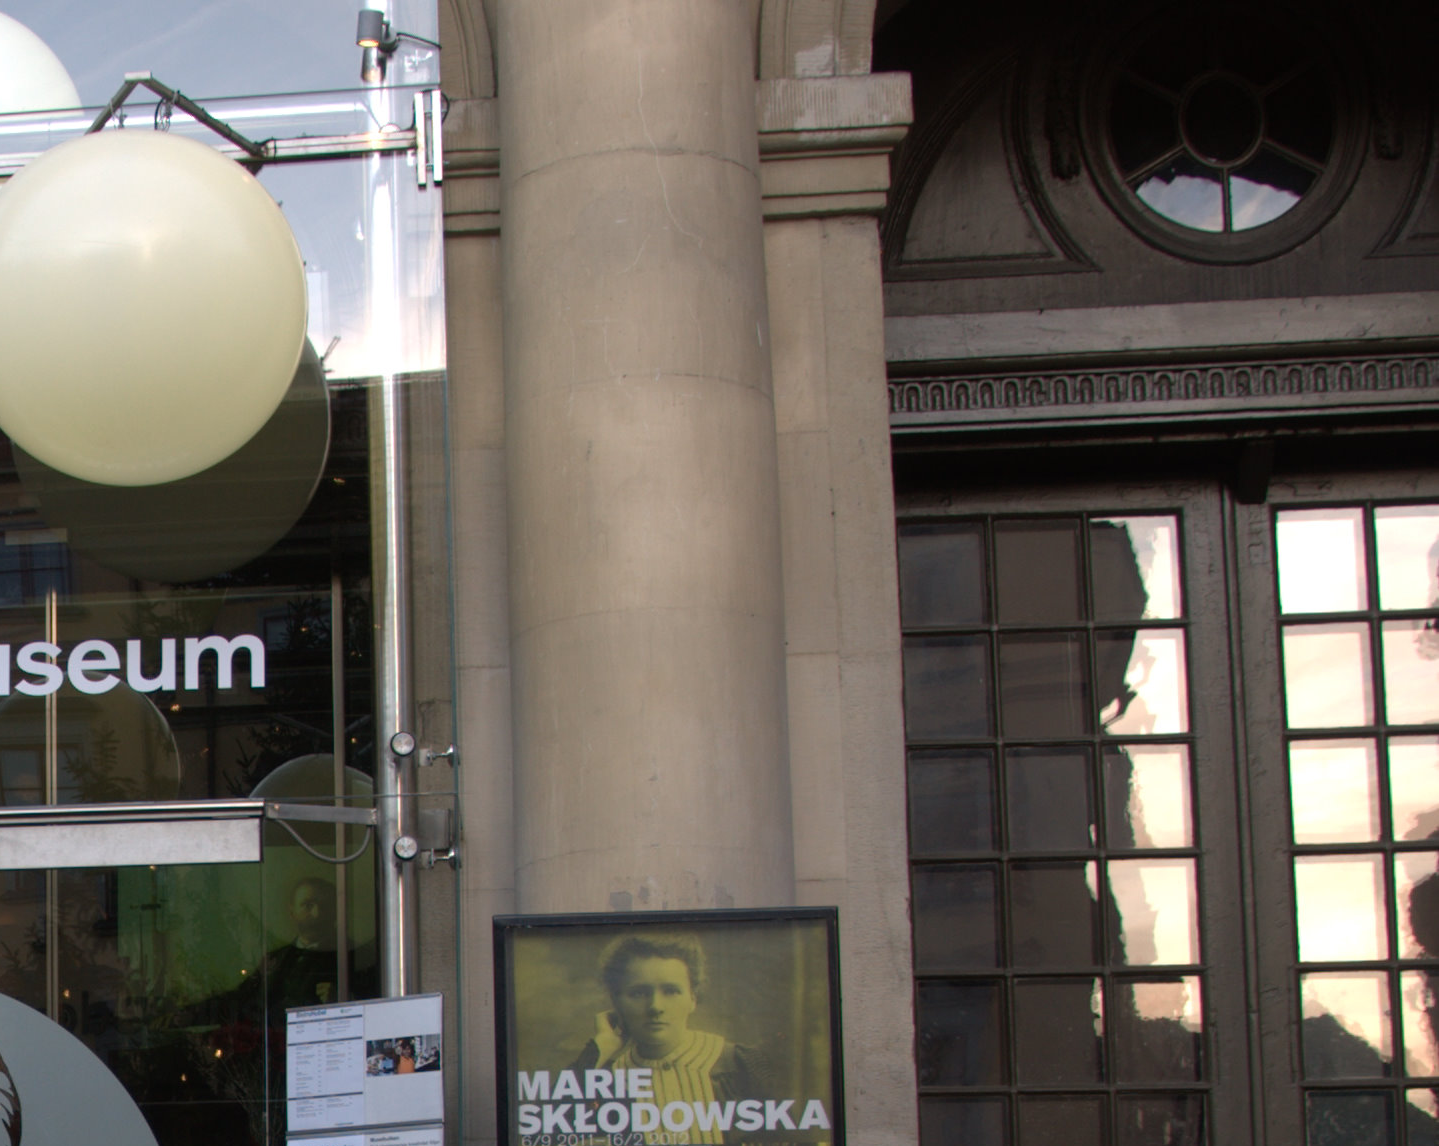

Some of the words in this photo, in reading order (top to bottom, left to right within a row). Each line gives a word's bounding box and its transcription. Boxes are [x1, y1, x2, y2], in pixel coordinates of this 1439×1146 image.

[518, 1068, 654, 1100] MARIE
[518, 1100, 831, 1135] SKŁODOWSKA
[649, 1132, 690, 1146] 2012
